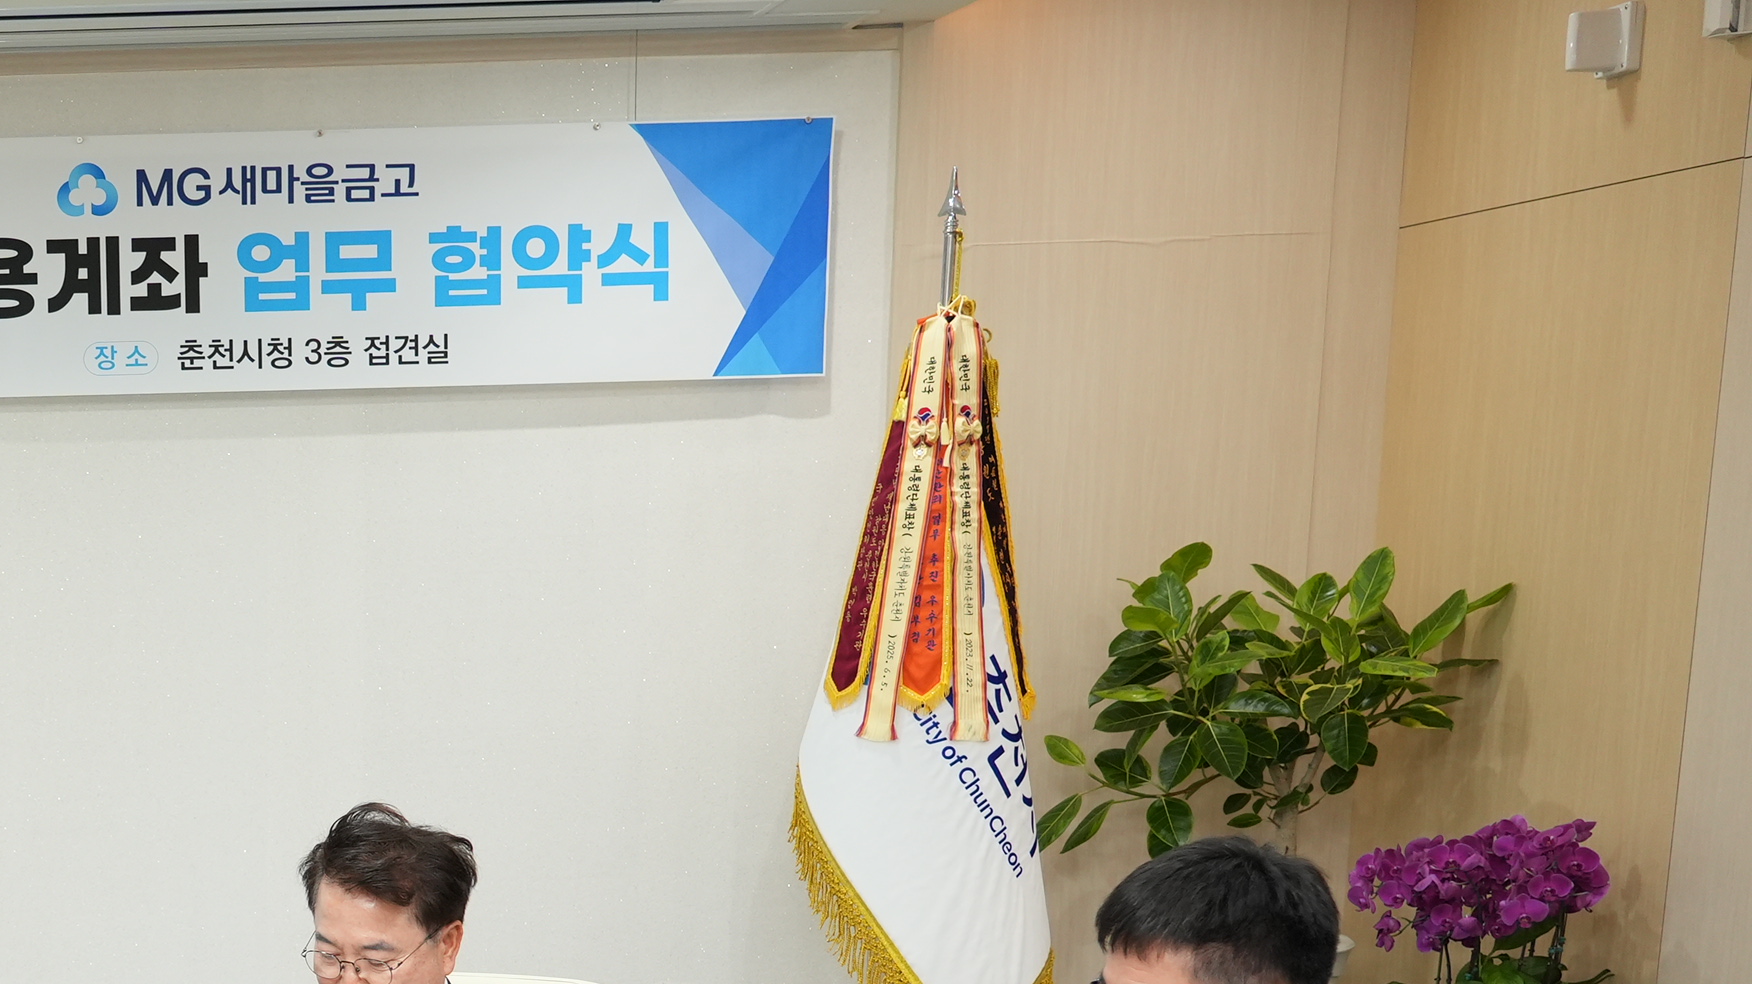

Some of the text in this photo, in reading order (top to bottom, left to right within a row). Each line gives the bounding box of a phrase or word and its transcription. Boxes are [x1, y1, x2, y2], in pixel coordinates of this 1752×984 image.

[235, 229, 397, 315] 업무
[427, 221, 671, 307] 협약식
[176, 337, 294, 372] 춘천시청
[304, 337, 353, 369] 3층
[363, 332, 451, 367] 접견실
[921, 356, 937, 395] 대한민국
[958, 354, 971, 393] 대한민국
[941, 745, 968, 767] of
[958, 766, 1024, 879] ChunCheon
